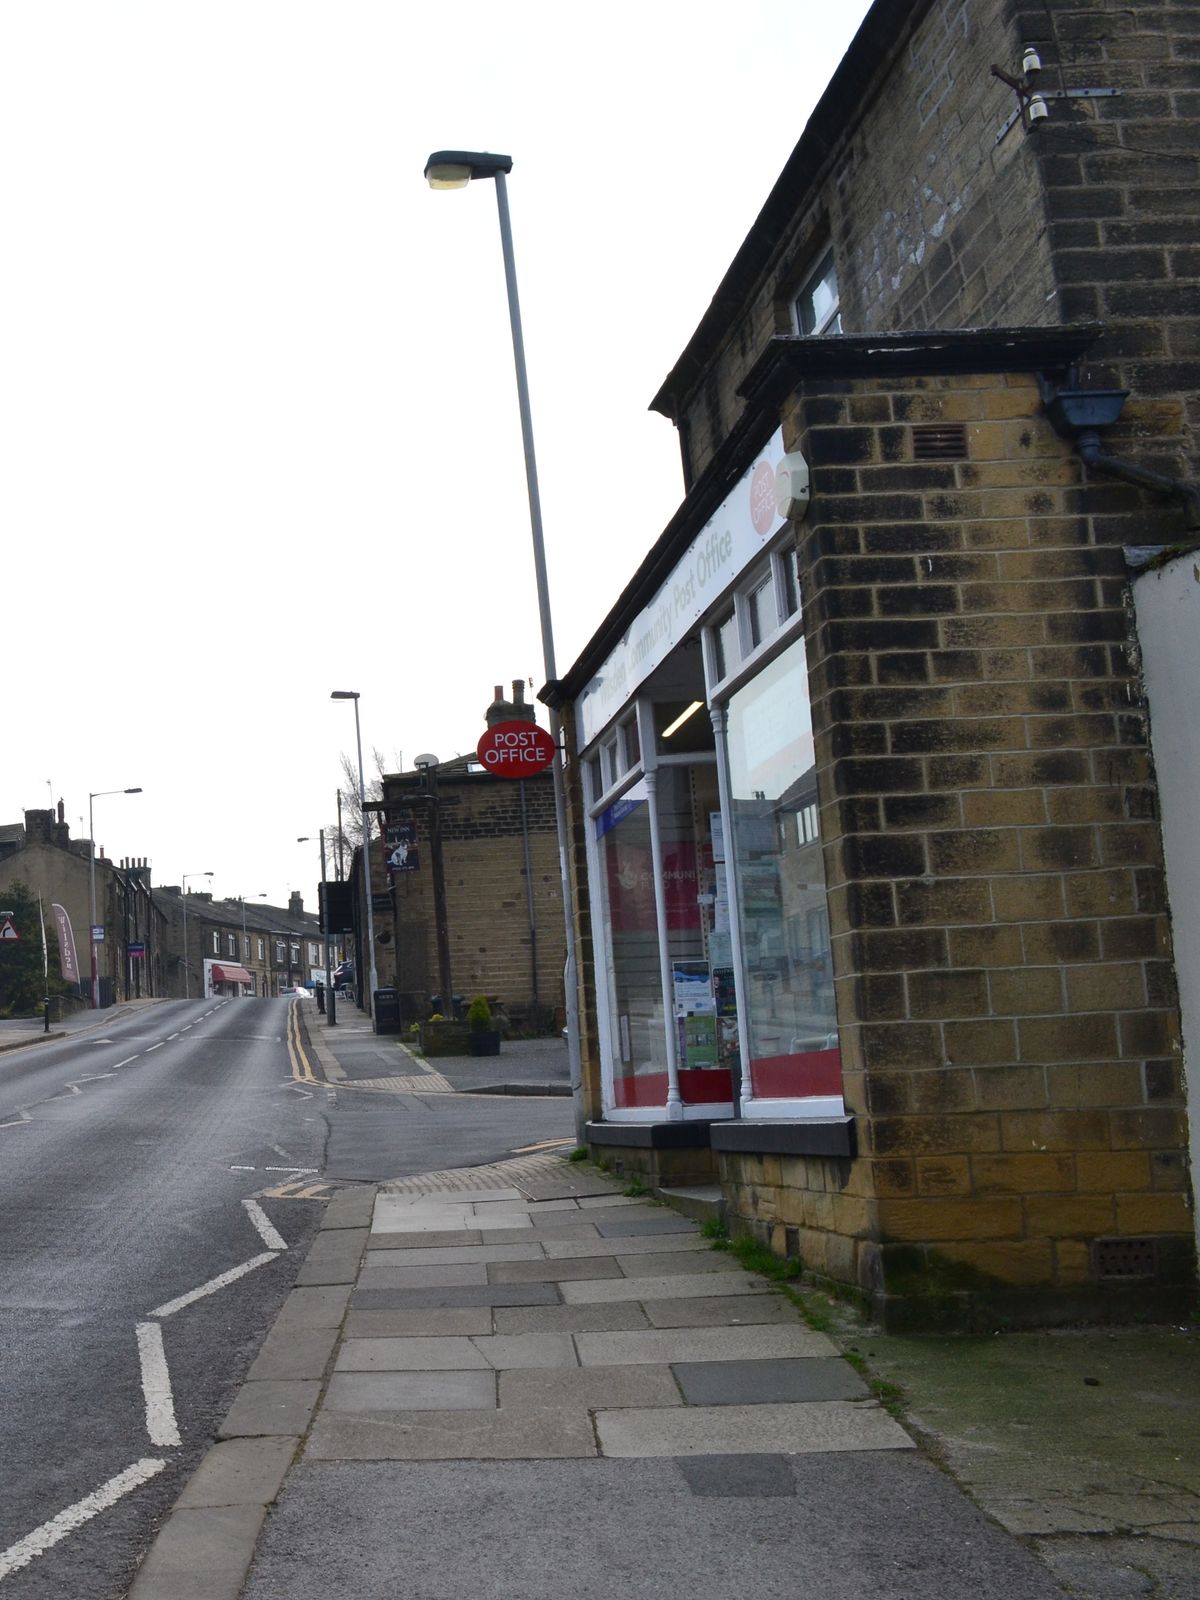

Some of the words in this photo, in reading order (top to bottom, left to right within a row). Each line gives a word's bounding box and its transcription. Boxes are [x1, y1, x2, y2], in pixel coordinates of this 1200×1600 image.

[625, 603, 672, 674] Community
[673, 567, 696, 618] Post
[697, 529, 732, 588] Office
[494, 731, 538, 747] POST
[485, 747, 546, 764] OFFICE
